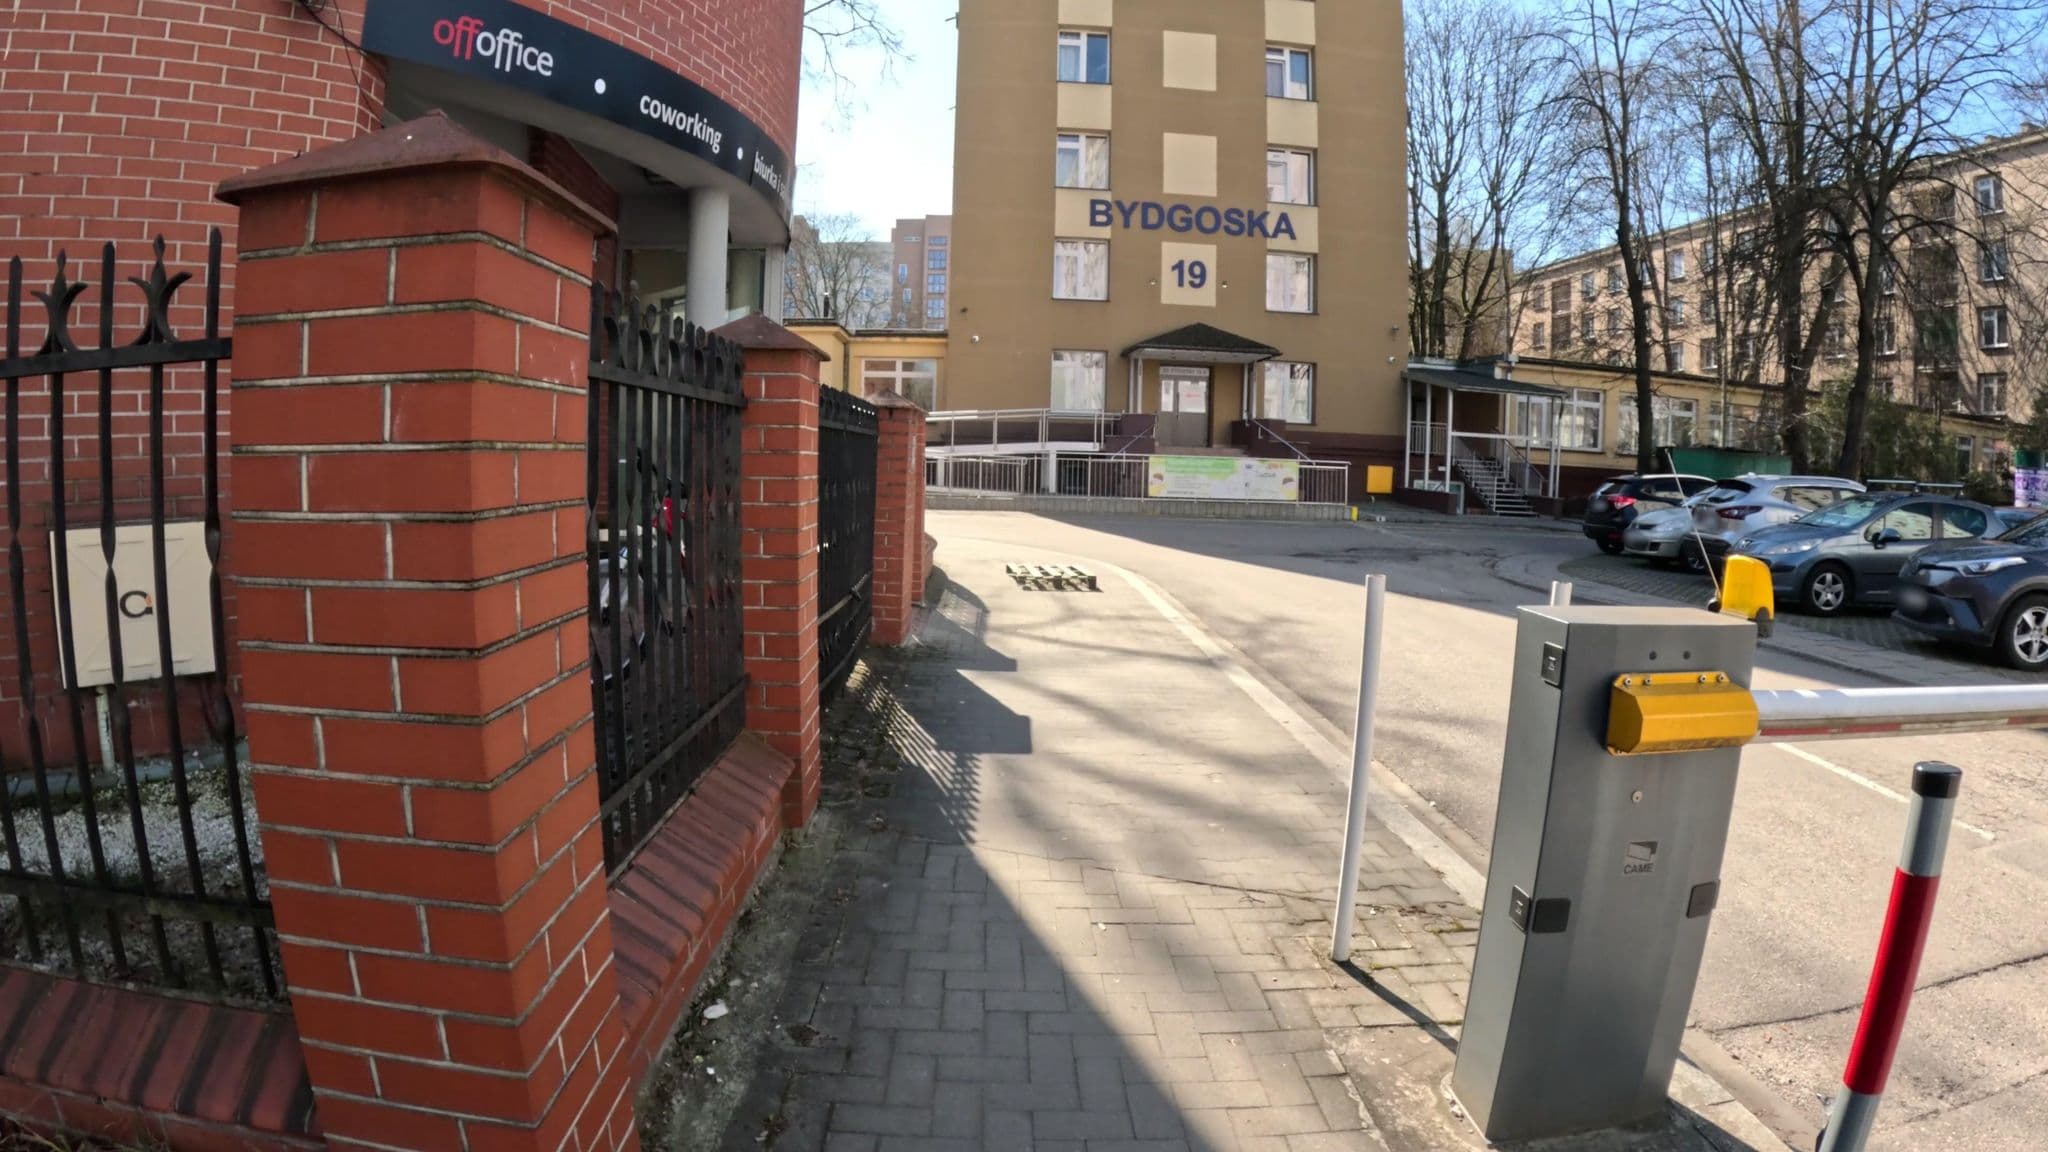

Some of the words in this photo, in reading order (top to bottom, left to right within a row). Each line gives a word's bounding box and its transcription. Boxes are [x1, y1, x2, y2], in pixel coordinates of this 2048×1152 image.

[639, 93, 722, 153] coworking
[753, 150, 778, 190] biurka
[1089, 199, 1297, 240] BYDGOSKA
[1170, 259, 1207, 289] 19
[1623, 862, 1655, 875] CAME
